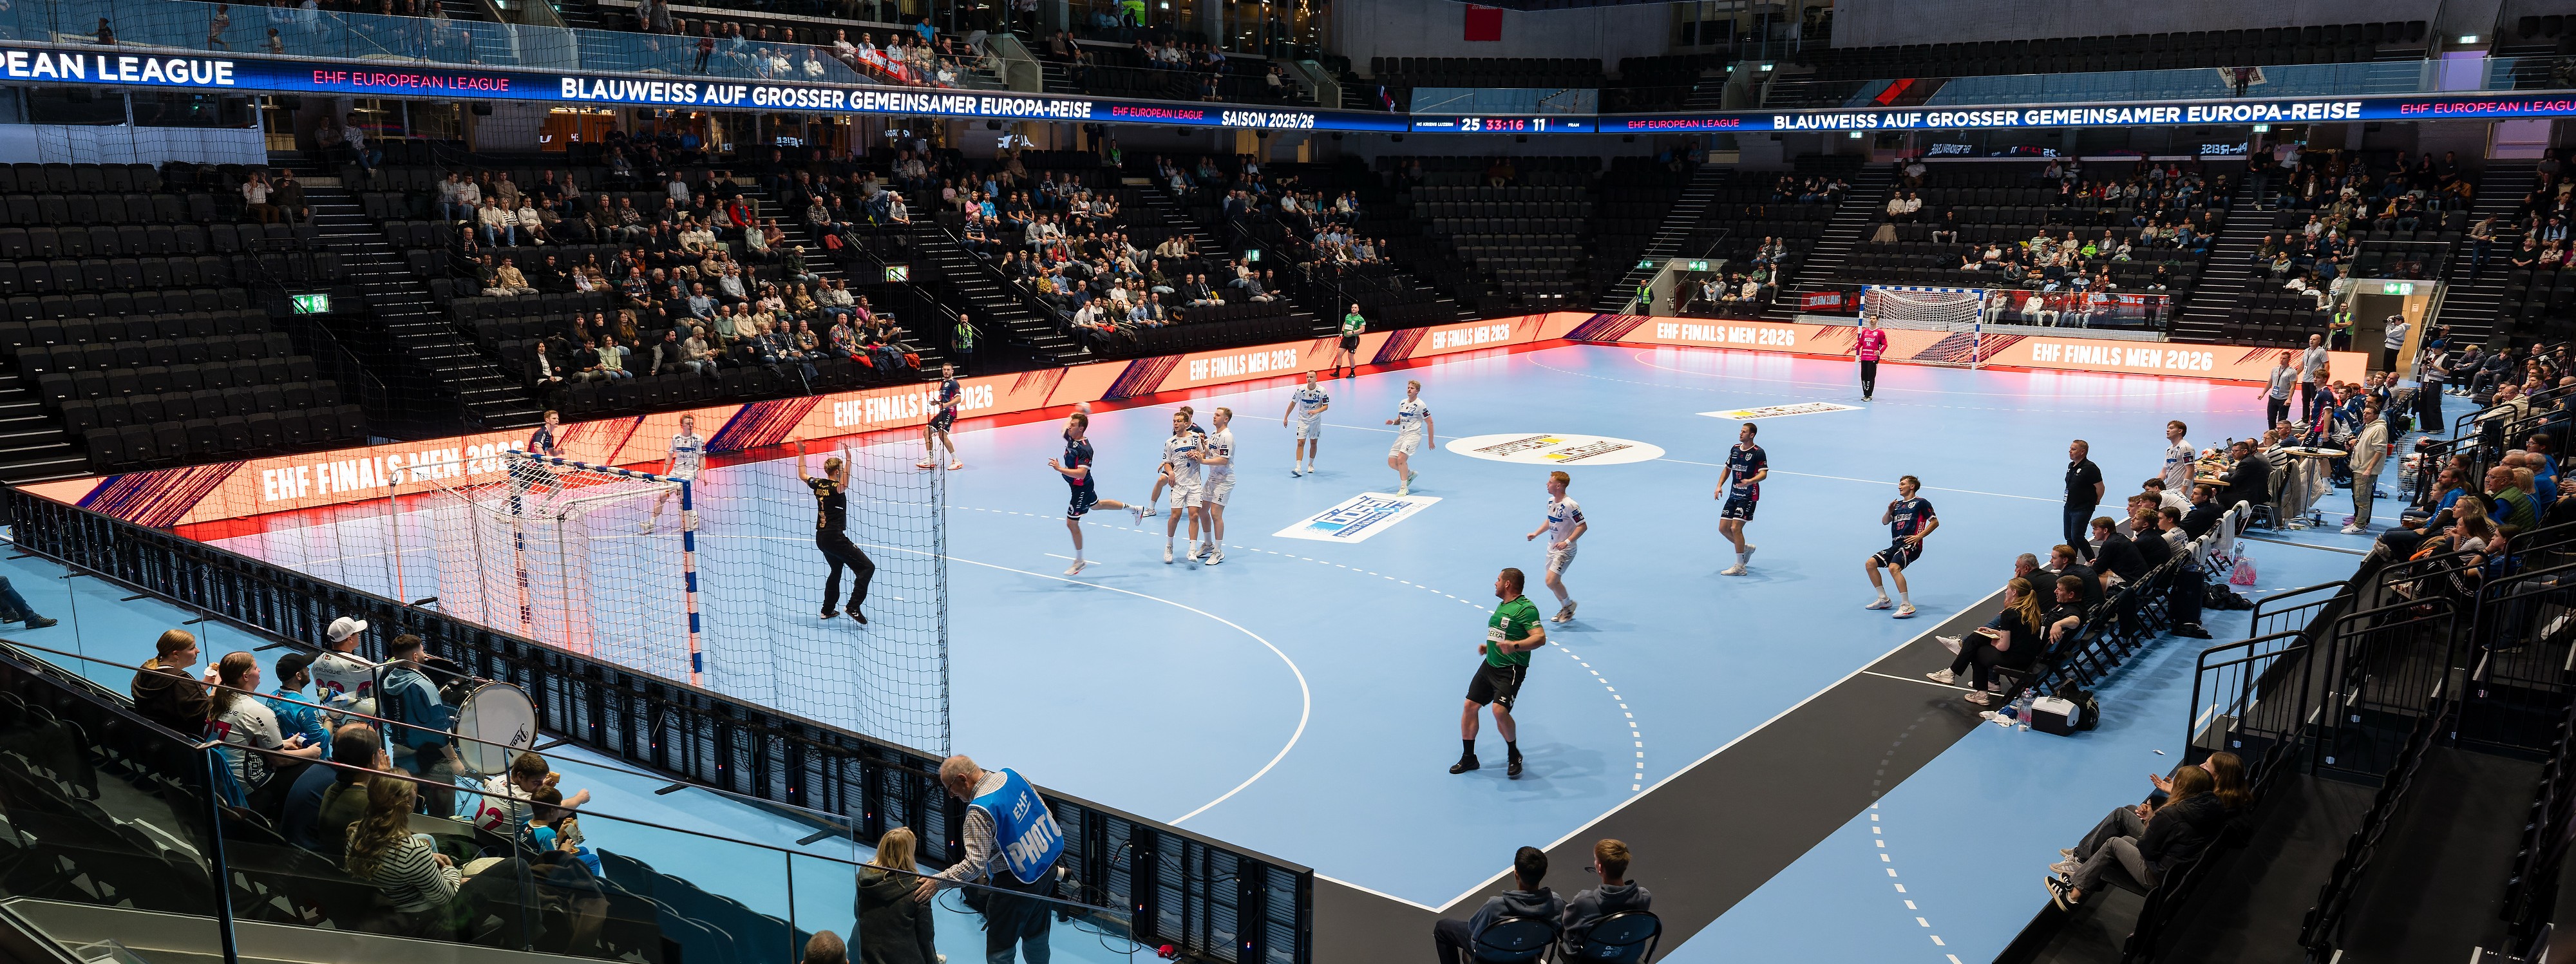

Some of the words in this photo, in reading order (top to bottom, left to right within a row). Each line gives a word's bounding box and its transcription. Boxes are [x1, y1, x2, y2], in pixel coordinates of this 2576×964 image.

[97, 55, 234, 85] LEAGUE
[314, 70, 346, 84] EHF
[353, 72, 443, 89] EUROPEAN
[449, 77, 509, 91] LEAGUE
[562, 77, 696, 103] BLAUWEISS
[703, 84, 746, 106] AUF
[752, 86, 844, 109] GROSSER
[849, 91, 976, 114] GEMEINSAMER
[981, 97, 1092, 118] EUROPA-REISE
[2400, 103, 2430, 114] EHF
[2434, 101, 2520, 113] EUROPEAN
[1112, 106, 1130, 116] EHF
[1132, 108, 1173, 118] EUROPEAN
[1174, 109, 1204, 120] LEAGUE
[1221, 111, 1265, 127] SAISON
[1269, 112, 1314, 129] 2025/26
[1461, 118, 1481, 131] 25
[1486, 119, 1524, 131] 33:16
[1533, 118, 1546, 131] 11
[1627, 120, 1646, 129] EHF
[1648, 119, 1700, 128] EUROPEAN
[1701, 118, 1739, 128] LEAGUE
[1773, 113, 1878, 129] BLAUWEISS
[1883, 112, 1922, 127] AUF
[1926, 110, 2018, 126] GROSSER
[2024, 106, 2179, 126] GEMEINSAMER
[2187, 102, 2362, 122] EUROPA-REISE
[1433, 331, 1446, 350] EHF
[1448, 328, 1473, 348] FINALS
[1474, 326, 1490, 345] MEN
[1491, 323, 1510, 342] 2026
[1657, 323, 1680, 339] EHF
[1681, 324, 1725, 343] FINALS
[1728, 326, 1756, 345] MEN
[1759, 328, 1795, 346] 2026
[1189, 359, 1209, 381] EHF
[1211, 354, 1246, 378] FINALS
[1248, 352, 1269, 373] MEN
[1271, 348, 1297, 370] 2026
[2032, 343, 2061, 362] EHF
[2064, 345, 2122, 366] FINALS
[2125, 348, 2163, 368] MEN
[2165, 350, 2213, 371] 2026
[834, 400, 862, 427] EHF
[865, 393, 918, 423] FINALS
[956, 384, 994, 411] 2026
[262, 465, 310, 502] EHF
[317, 453, 405, 495] FINALS
[410, 448, 462, 483] MEN
[1555, 507, 1563, 518] 13
[508, 723, 529, 758] Peal
[1012, 790, 1027, 820] EHF
